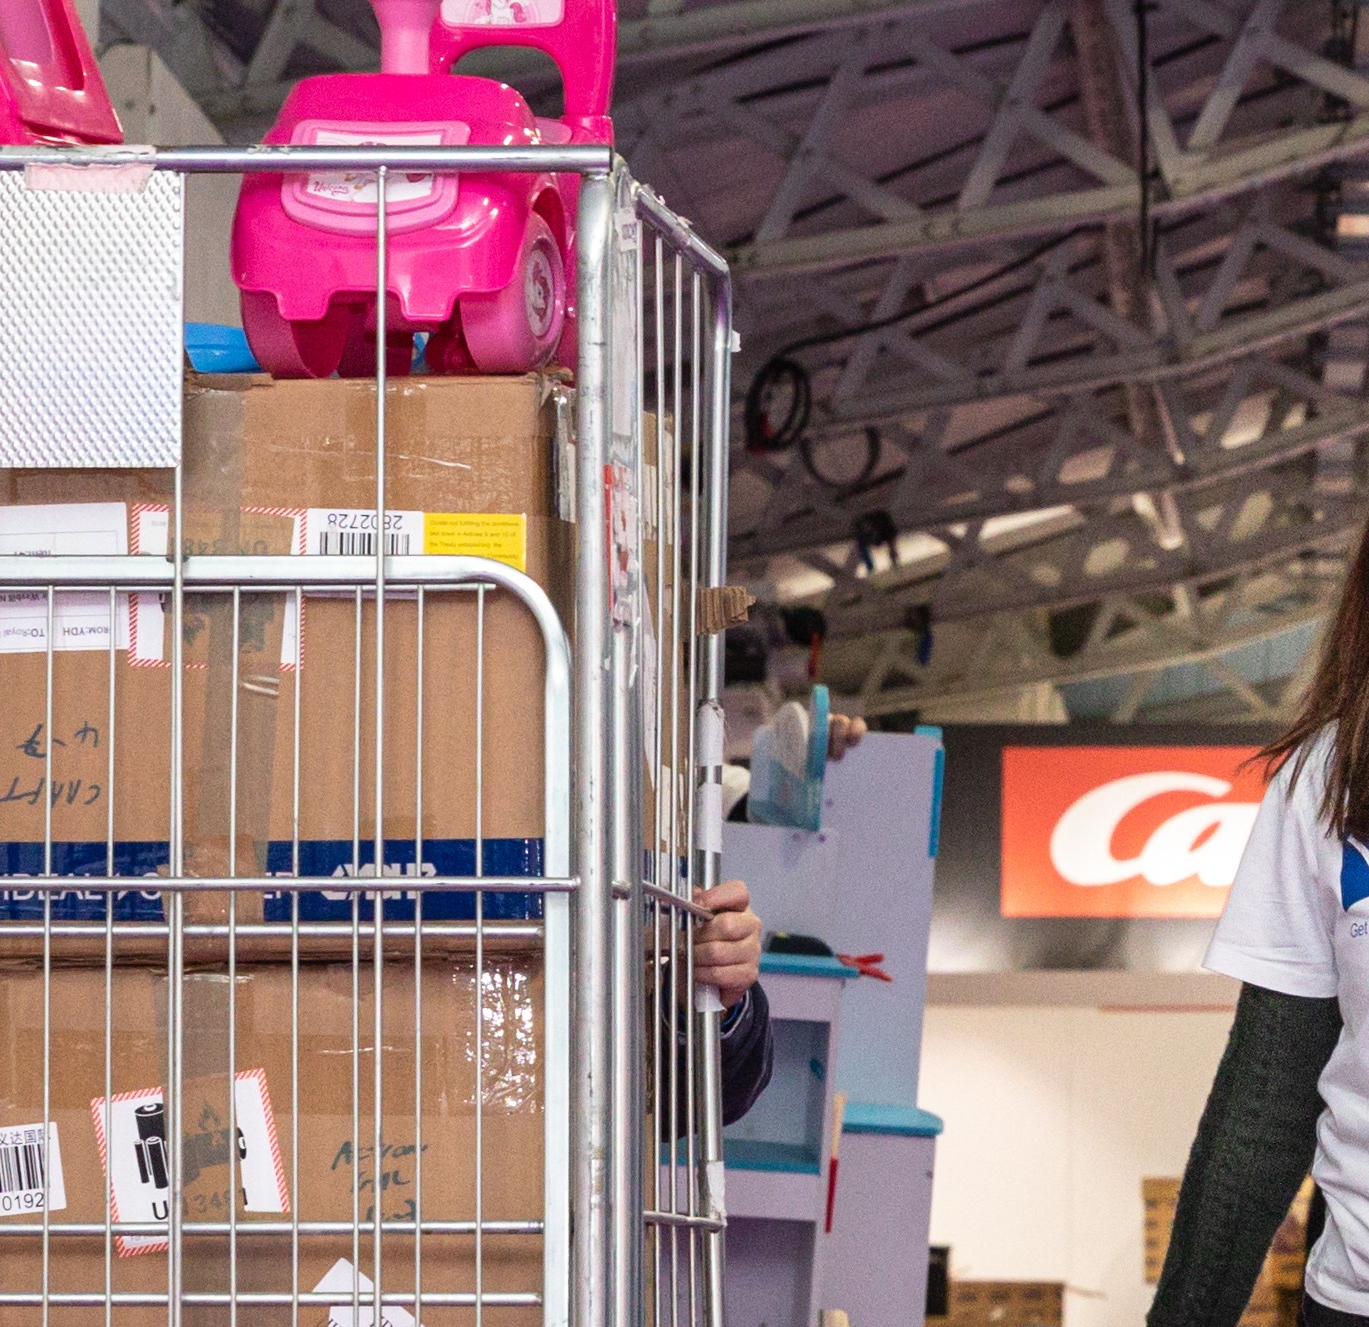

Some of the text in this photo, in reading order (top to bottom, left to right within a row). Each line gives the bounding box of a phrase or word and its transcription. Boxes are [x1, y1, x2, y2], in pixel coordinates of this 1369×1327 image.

[327, 513, 403, 530] 2802728
[63, 626, 110, 637] ROM:YDH
[1049, 771, 1261, 888] Ca
[1350, 921, 1369, 939] Get
